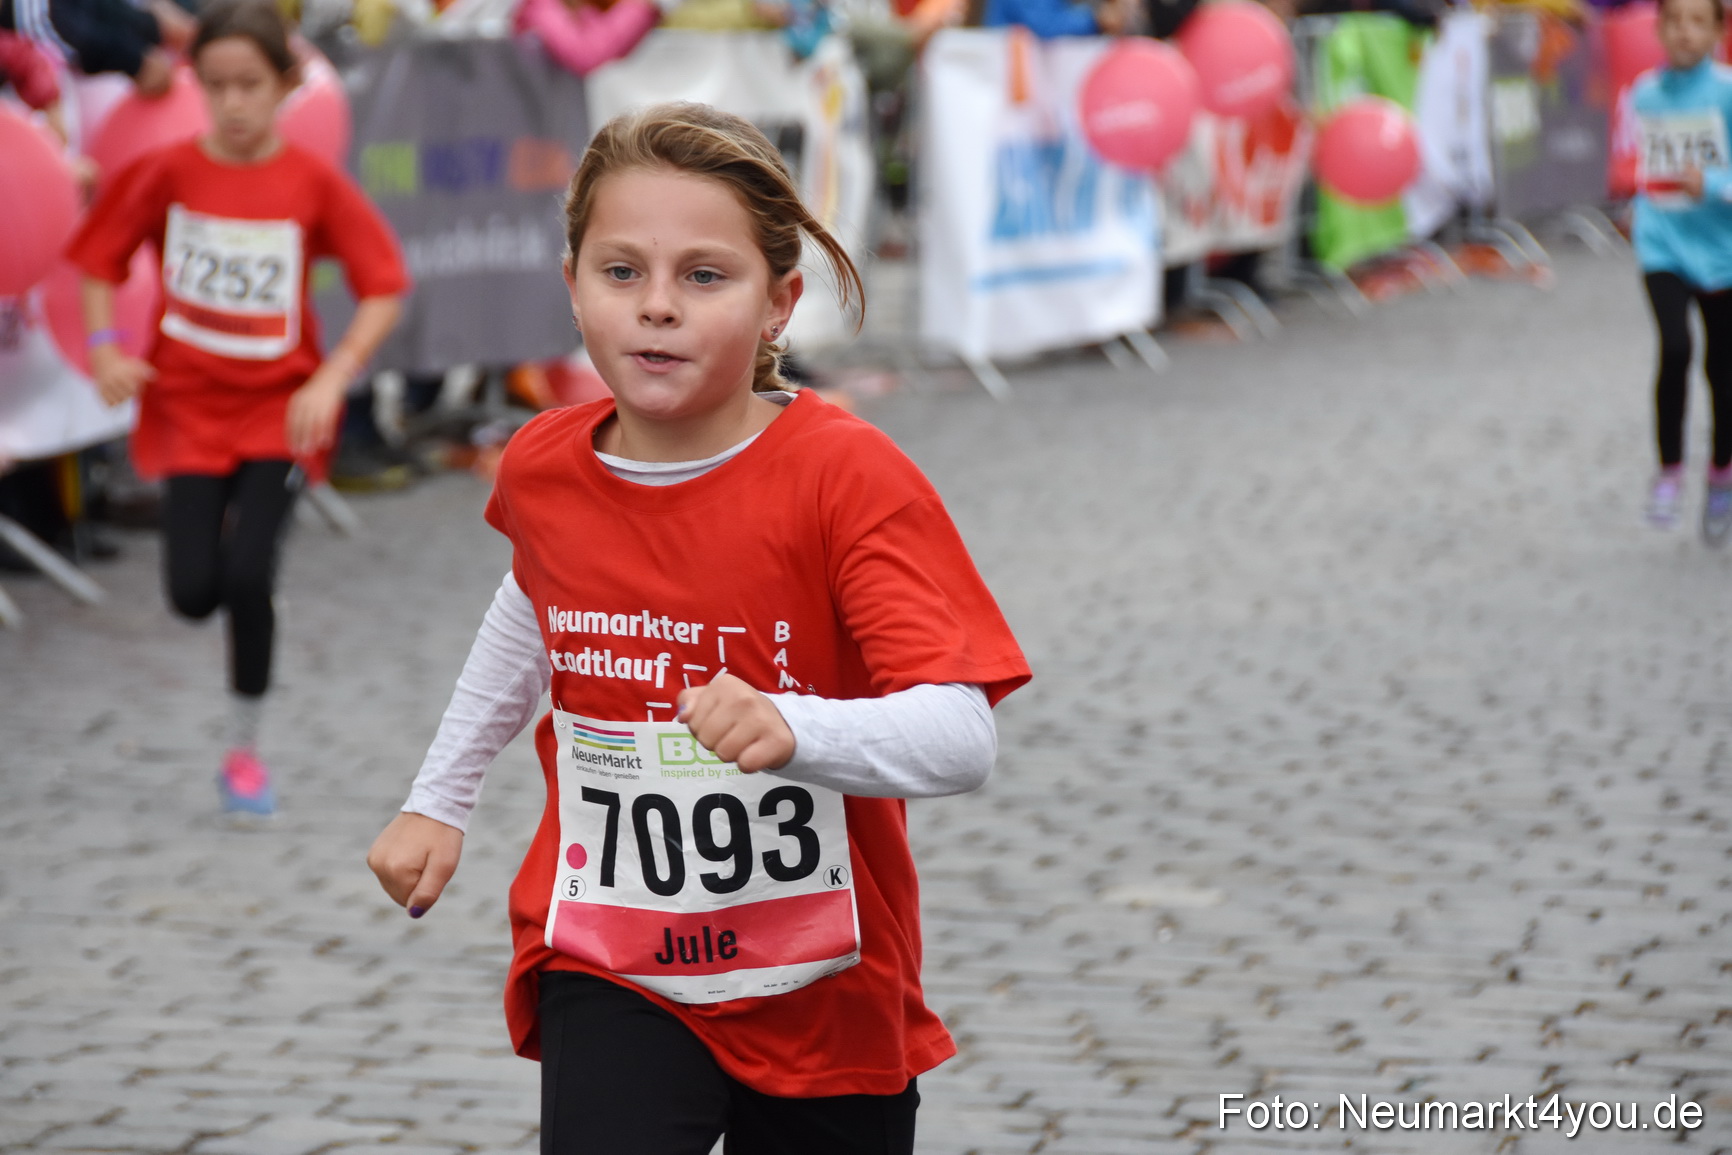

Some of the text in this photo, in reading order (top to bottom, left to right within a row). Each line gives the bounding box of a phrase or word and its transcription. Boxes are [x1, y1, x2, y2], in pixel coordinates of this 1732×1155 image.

[179, 243, 285, 302] 7252
[548, 606, 704, 645] Neumarkter
[550, 647, 672, 688] tadtlauf
[571, 746, 643, 770] NeuerMarkt
[660, 767, 704, 780] inspired
[708, 767, 722, 779] by
[581, 785, 821, 897] 7093
[568, 879, 579, 897] 5
[829, 867, 843, 886] K
[655, 926, 738, 965] Jule
